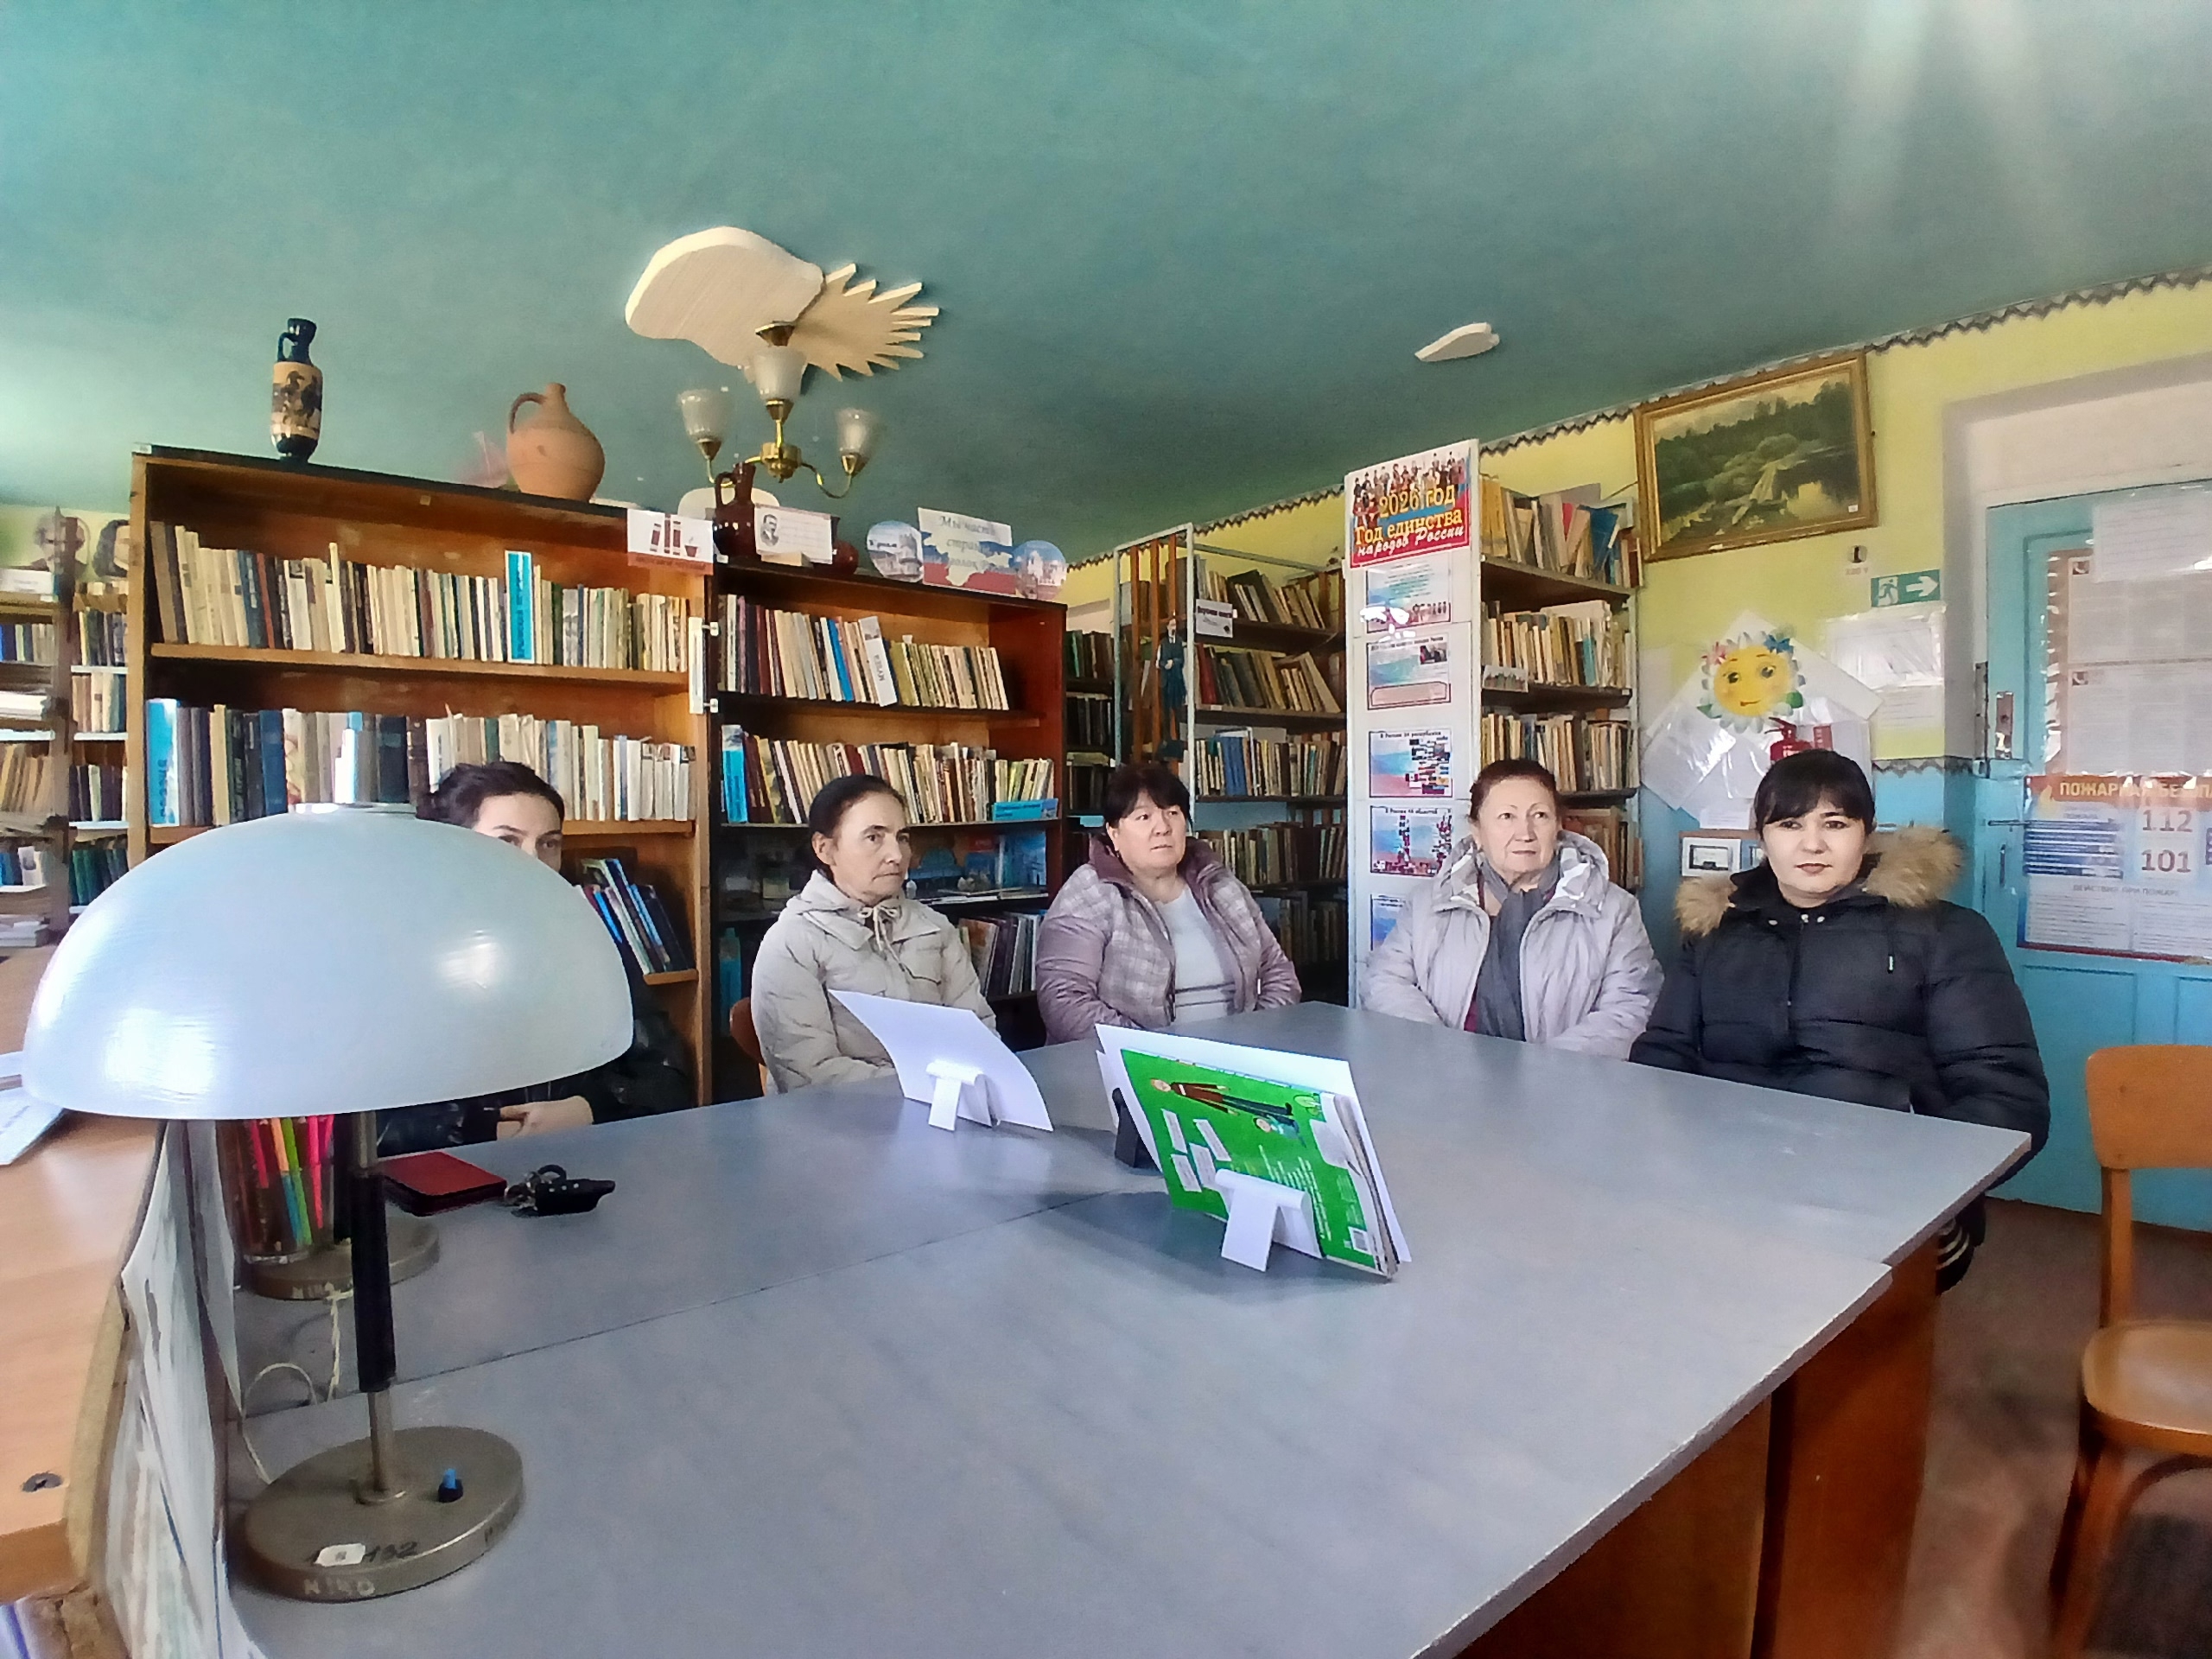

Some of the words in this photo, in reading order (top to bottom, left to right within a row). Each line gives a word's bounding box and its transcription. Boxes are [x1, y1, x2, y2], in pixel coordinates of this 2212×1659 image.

[1379, 488, 1420, 518] 2026
[1354, 527, 1384, 546] Год
[1387, 508, 1463, 537] единства
[1357, 534, 1409, 557] народов
[1414, 524, 1465, 546] России
[2141, 809, 2193, 833] 112
[2141, 849, 2191, 874] 101
